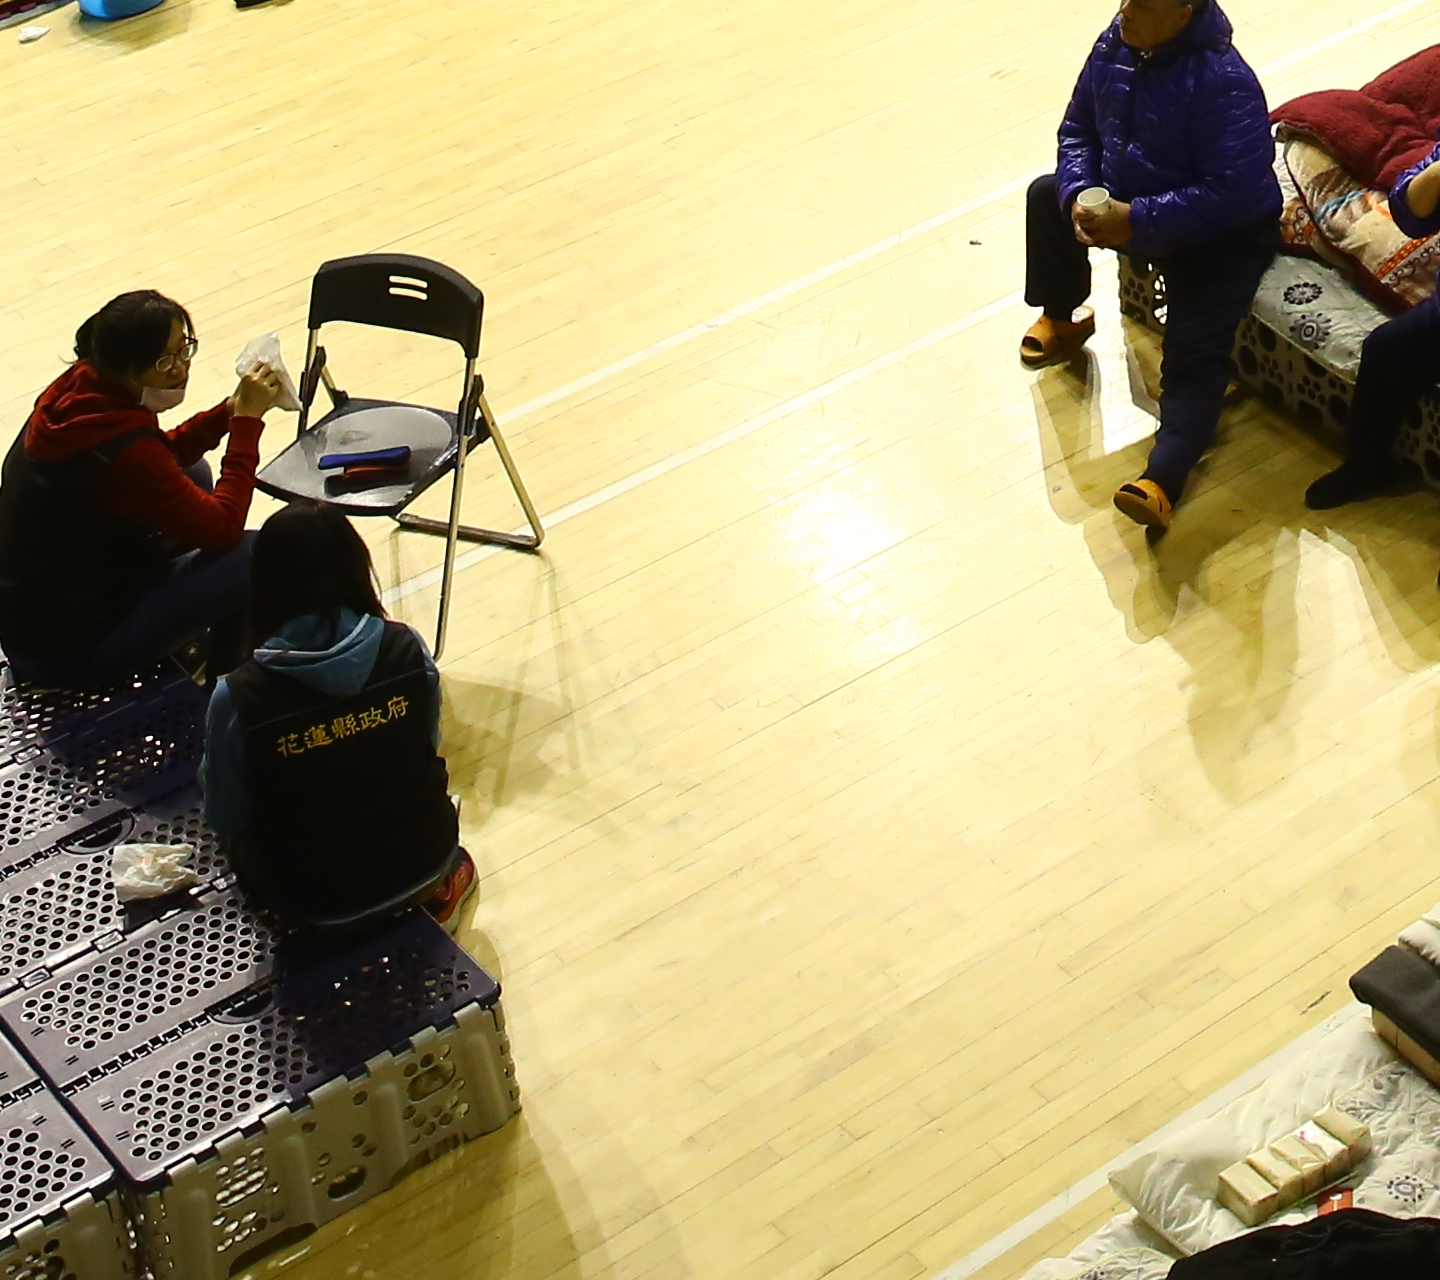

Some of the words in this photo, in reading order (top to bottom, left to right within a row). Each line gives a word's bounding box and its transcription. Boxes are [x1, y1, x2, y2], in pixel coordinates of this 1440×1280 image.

[276, 695, 410, 758] 花蓮縣政府
